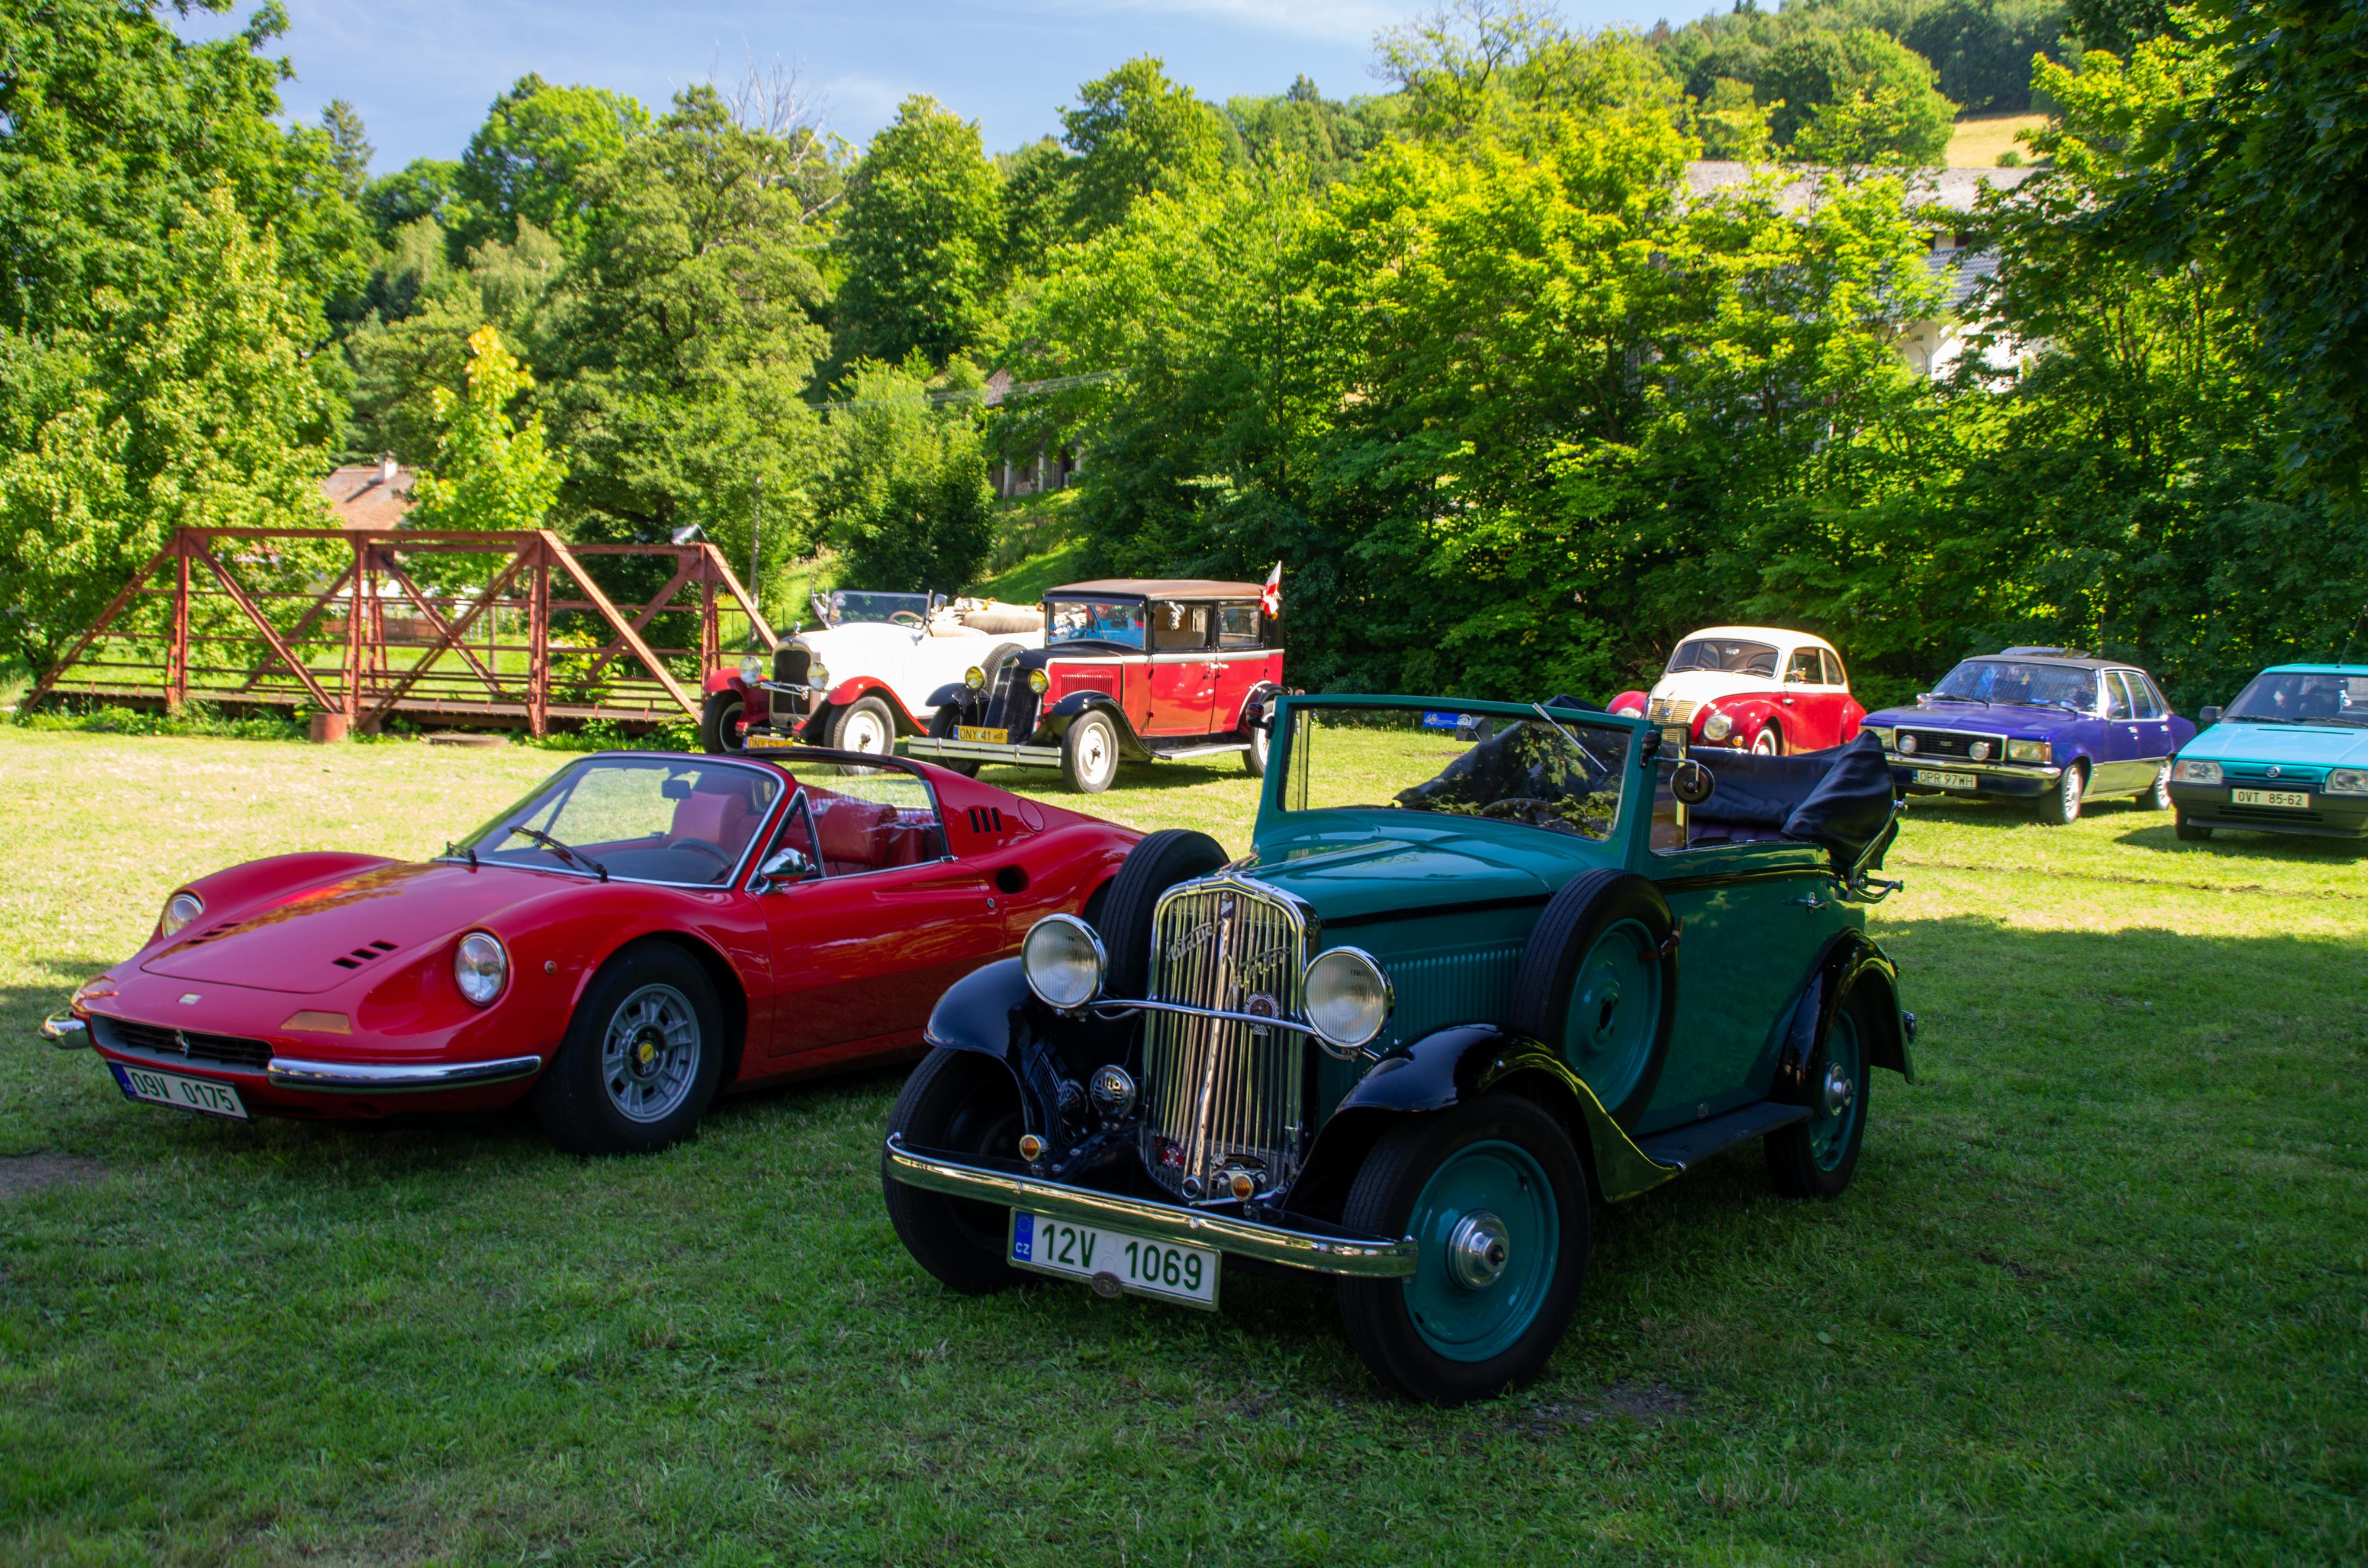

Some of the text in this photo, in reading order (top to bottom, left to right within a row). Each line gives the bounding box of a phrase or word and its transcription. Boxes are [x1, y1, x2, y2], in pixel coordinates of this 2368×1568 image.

[960, 728, 977, 740] ONY
[980, 730, 990, 741] 41
[748, 738, 765, 748] ONY
[1920, 771, 1973, 787] OPR 97WH
[2238, 791, 2302, 805] OVT 85-62
[130, 1072, 236, 1112] 09V 0175
[1015, 1242, 1029, 1255] CZ
[1042, 1224, 1096, 1268] 12V
[1125, 1241, 1202, 1291] 1069
